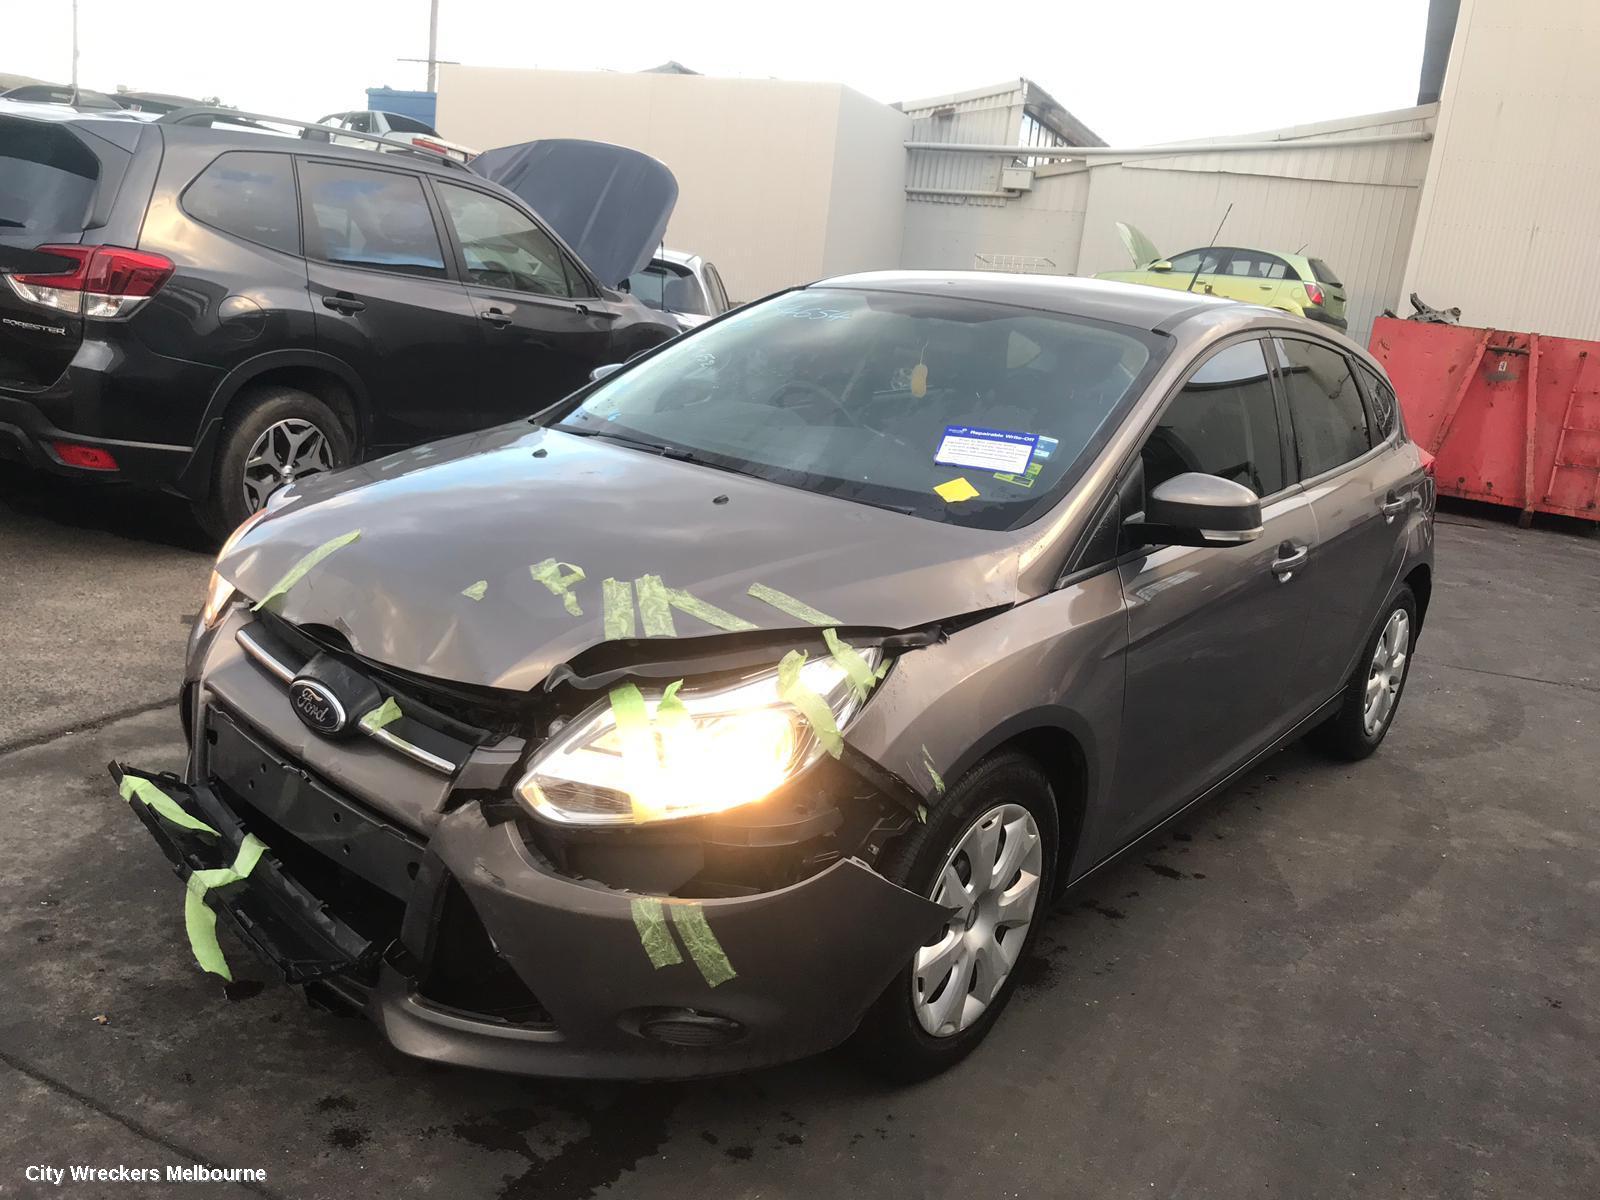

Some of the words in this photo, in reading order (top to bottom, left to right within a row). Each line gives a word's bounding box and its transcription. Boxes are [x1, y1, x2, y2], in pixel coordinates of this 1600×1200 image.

[2, 318, 66, 336] FORESTER
[970, 430, 1004, 438] Repairable
[1005, 433, 1035, 442] Write-Off
[297, 687, 329, 722] Ford
